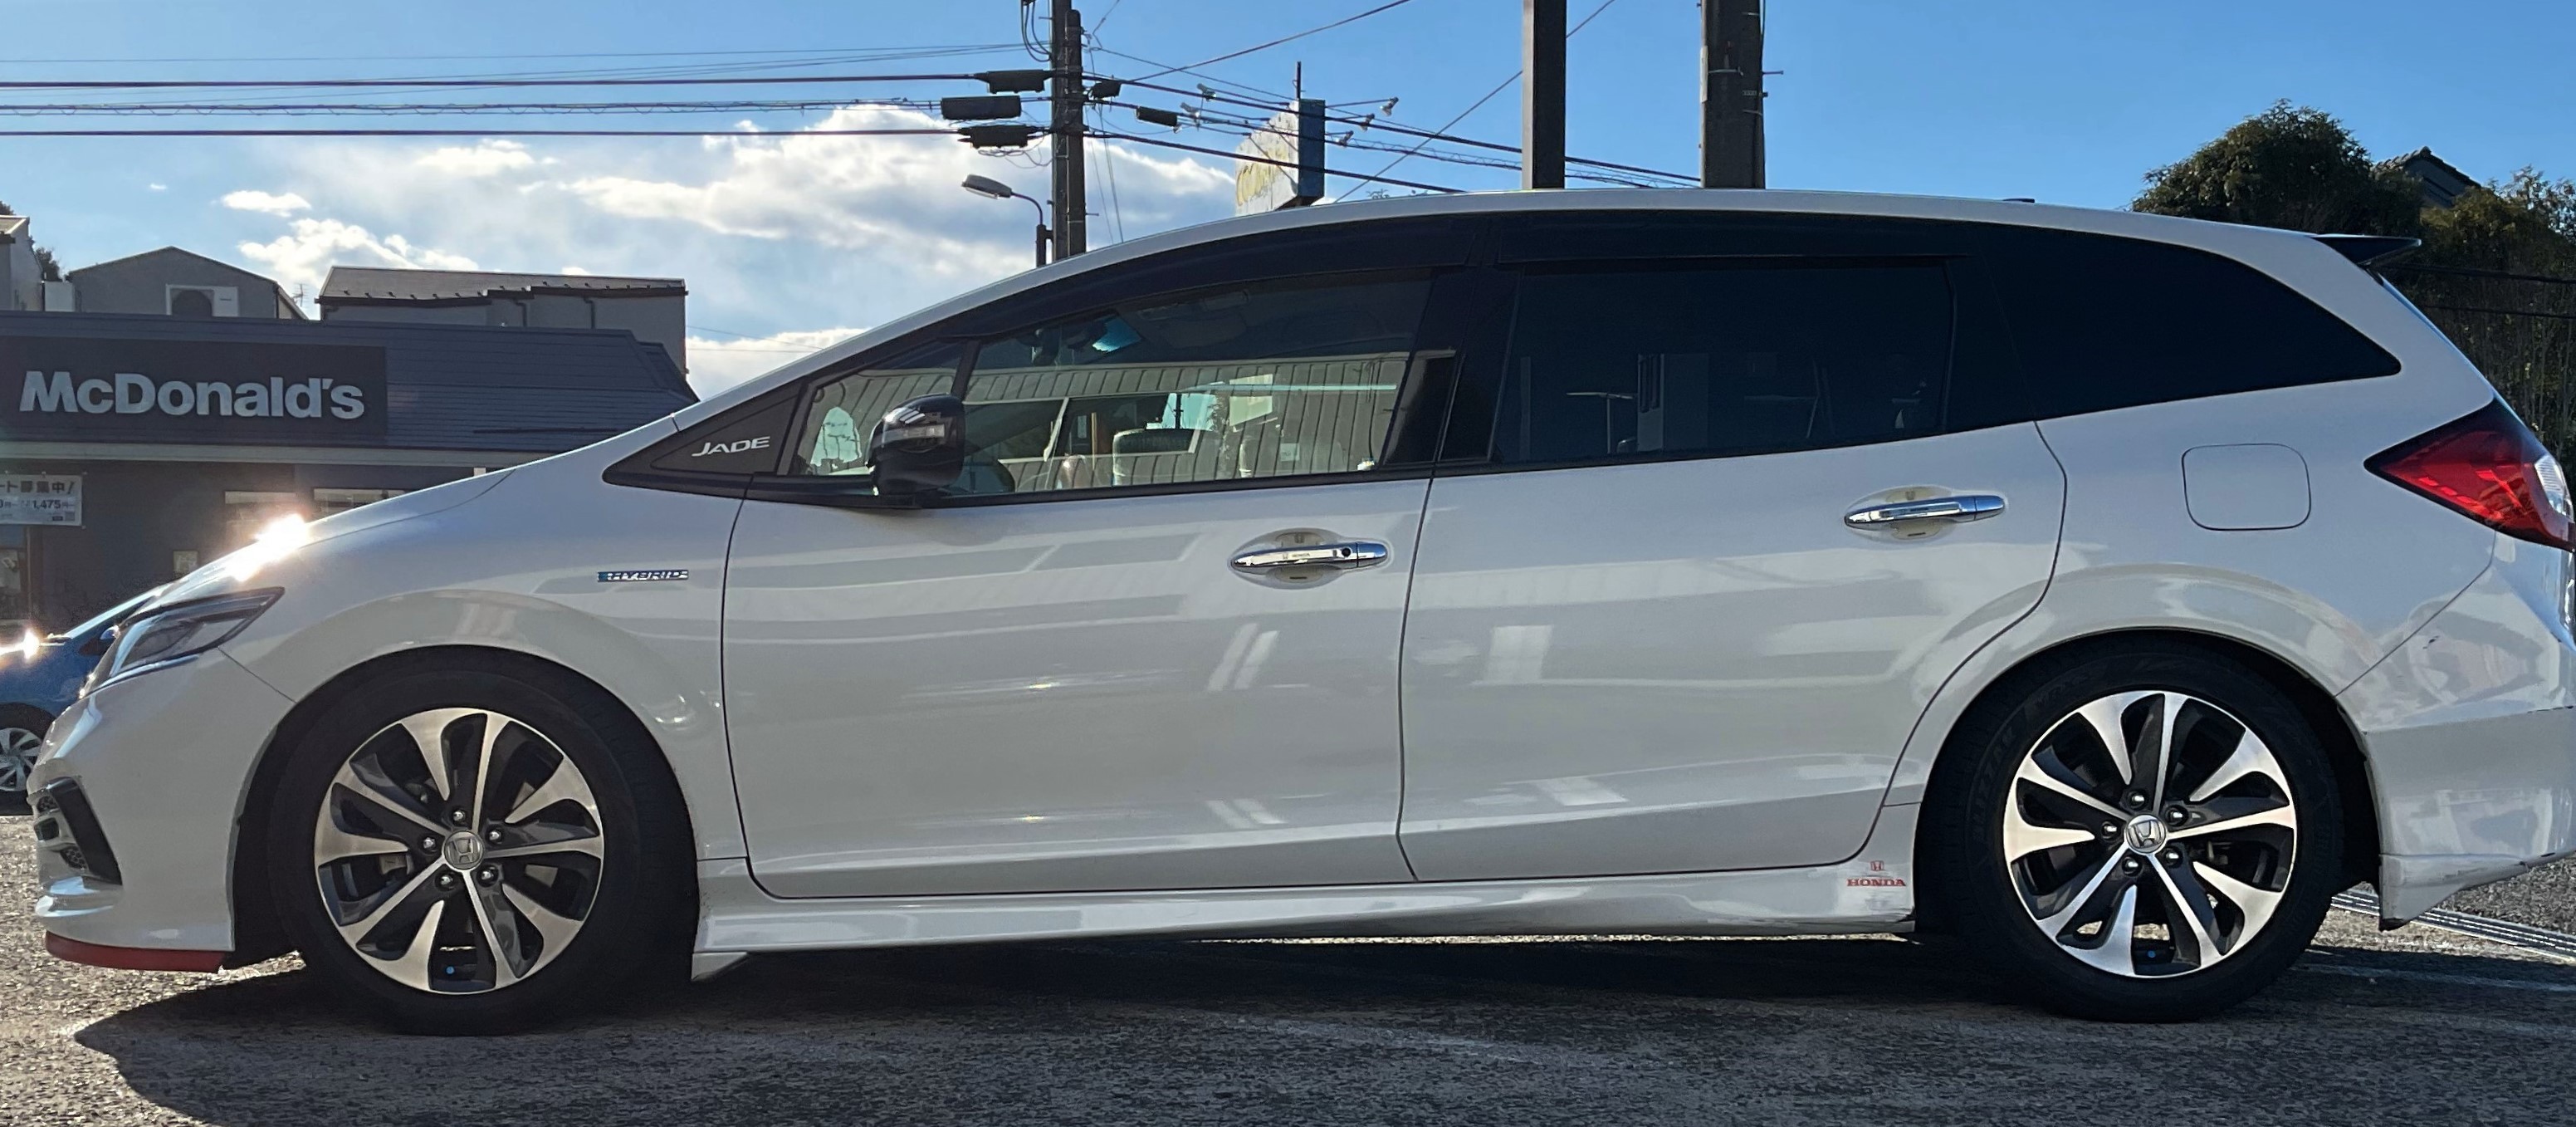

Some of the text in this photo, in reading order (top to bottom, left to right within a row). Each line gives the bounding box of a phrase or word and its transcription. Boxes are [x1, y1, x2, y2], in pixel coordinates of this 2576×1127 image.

[19, 370, 364, 419] McDonald's
[692, 436, 770, 457] JADE
[1847, 879, 1906, 887] HONDA
